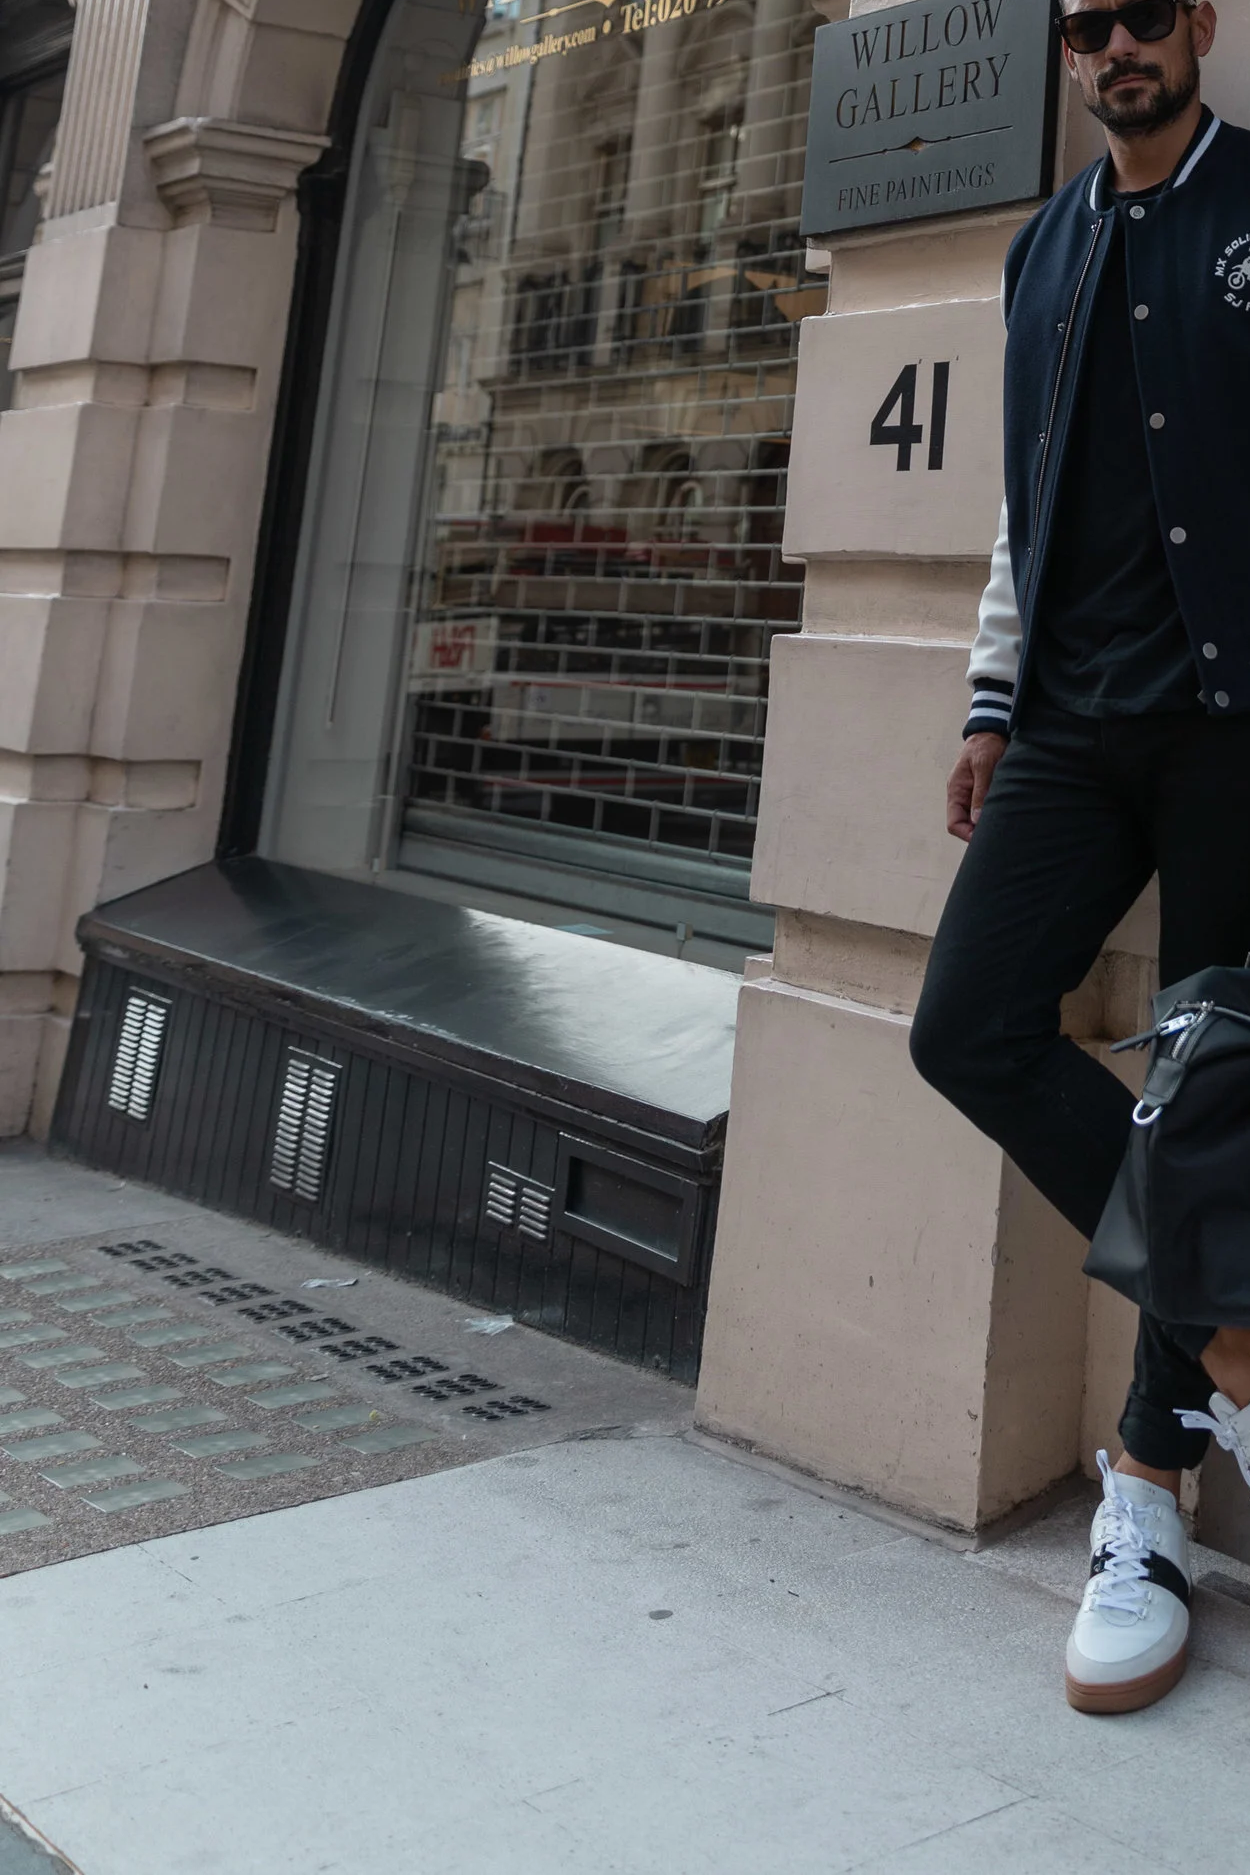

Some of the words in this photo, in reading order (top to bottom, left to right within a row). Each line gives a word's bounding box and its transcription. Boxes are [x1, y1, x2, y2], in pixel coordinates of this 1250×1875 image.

[836, 53, 1012, 129] GALLERY
[838, 182, 881, 211] FINE
[886, 162, 996, 202] PAINTINGS
[1215, 257, 1228, 277] MX
[1223, 292, 1243, 308] SJ
[870, 361, 950, 471] 41
